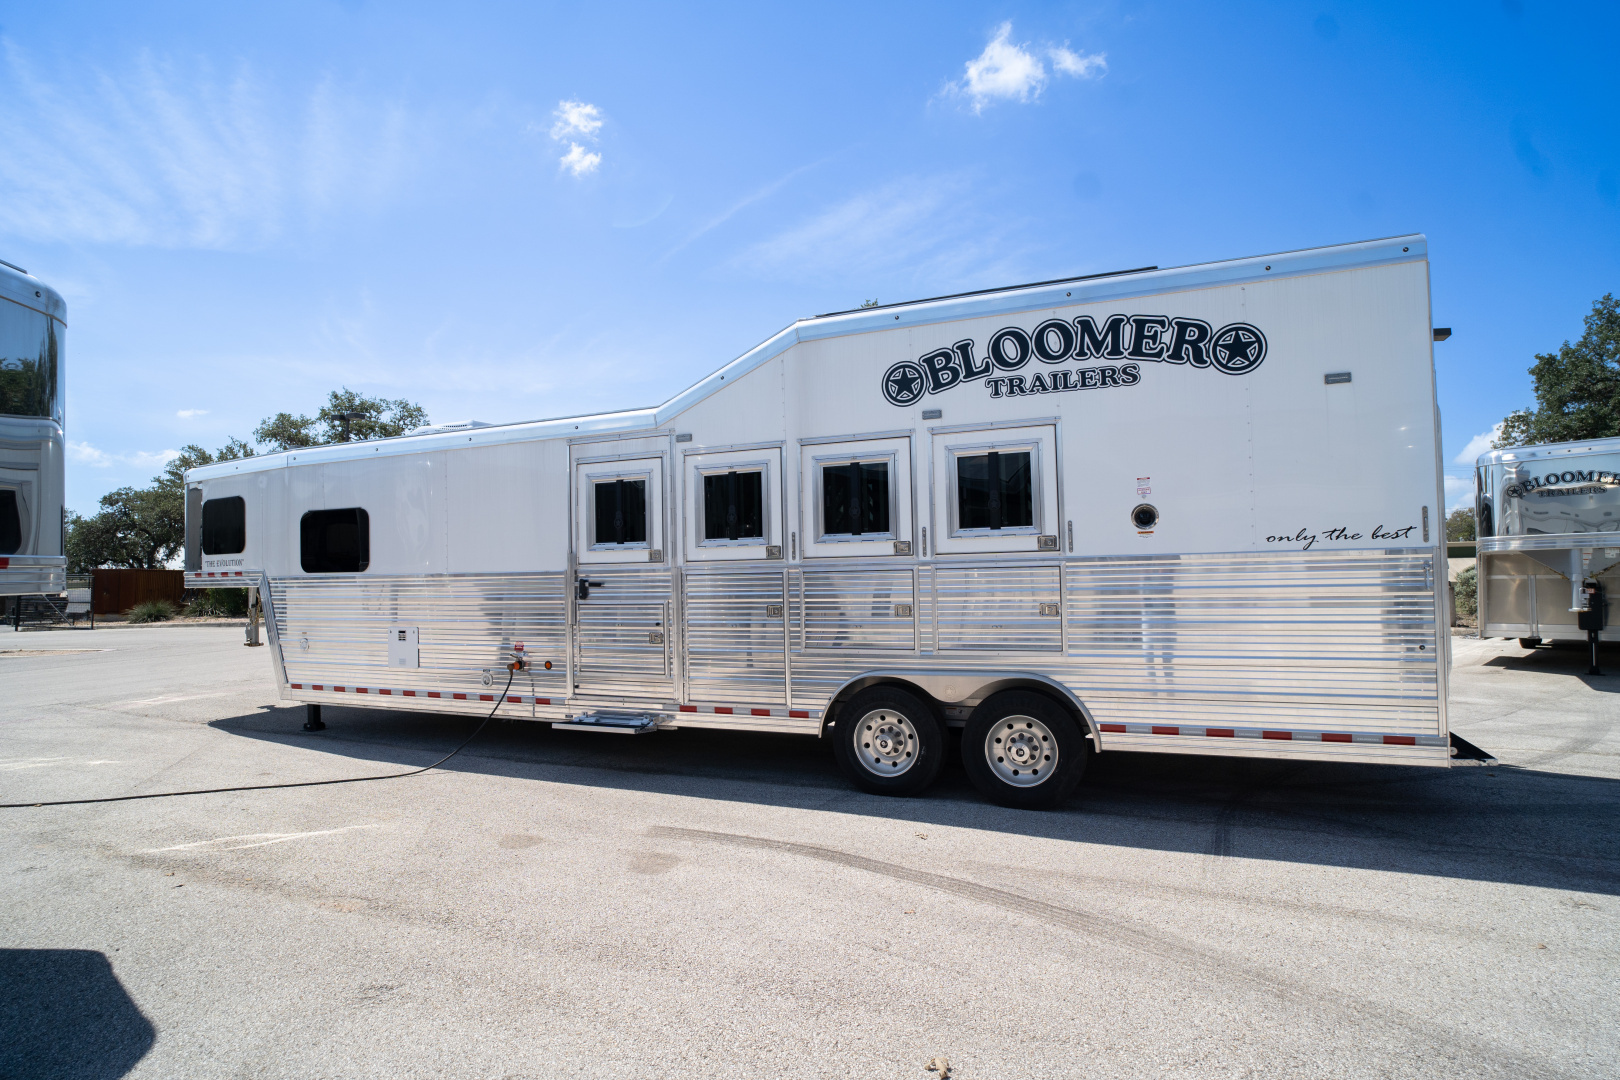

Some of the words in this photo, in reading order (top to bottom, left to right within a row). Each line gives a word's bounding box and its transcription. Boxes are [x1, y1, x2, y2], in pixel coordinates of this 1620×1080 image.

[919, 313, 1212, 395] BLOOMER
[985, 363, 1141, 398] TRAILERS
[1537, 485, 1608, 498] TRAILERS
[1266, 527, 1319, 550] only
[1322, 526, 1363, 541] the
[1371, 524, 1418, 540] best
